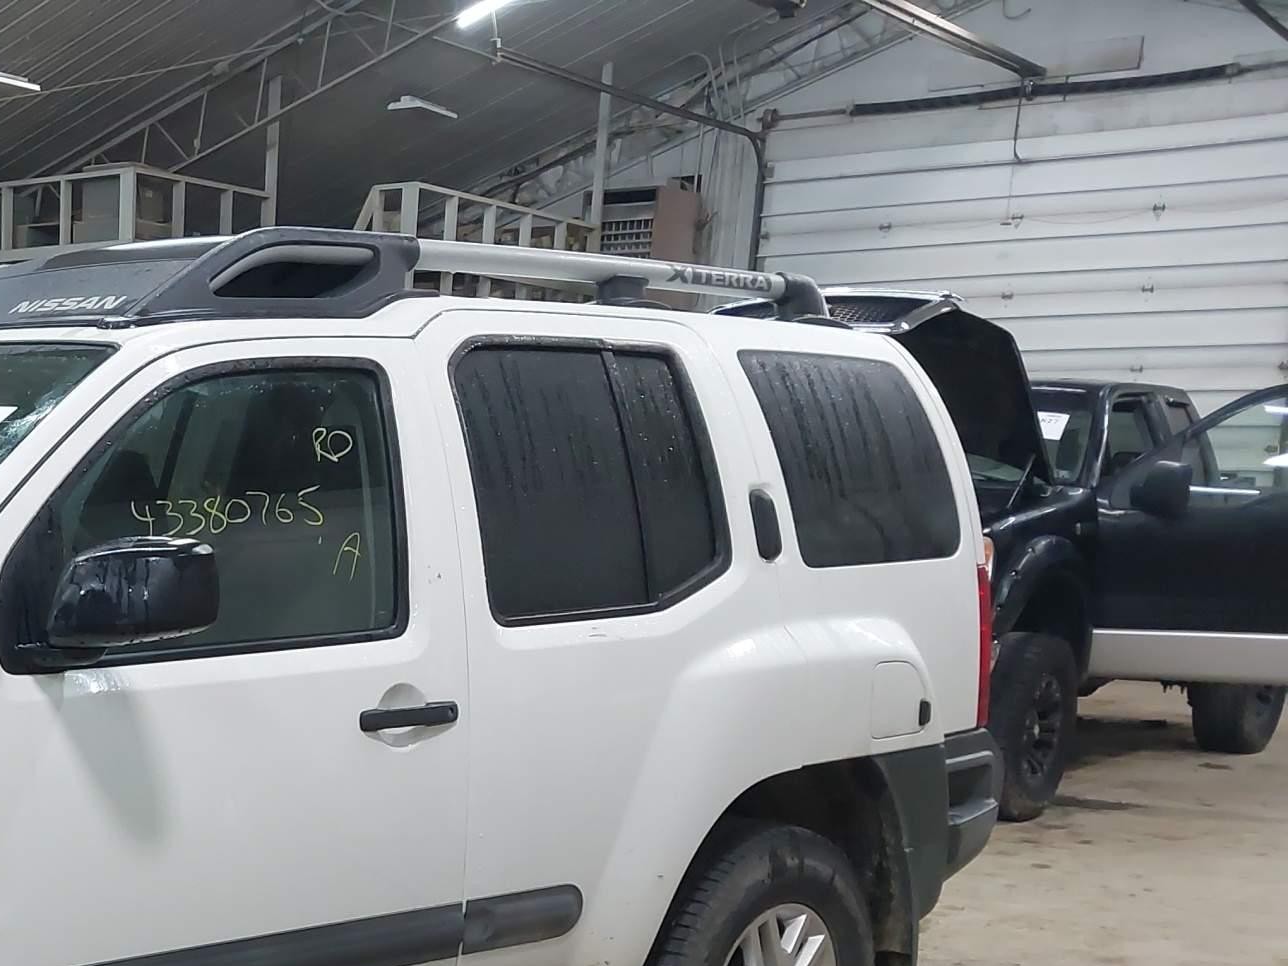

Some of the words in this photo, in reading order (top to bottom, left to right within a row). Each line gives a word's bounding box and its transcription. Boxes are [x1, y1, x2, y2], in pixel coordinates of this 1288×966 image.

[666, 267, 773, 292] XTERRA
[8, 295, 127, 314] NISSAN
[131, 485, 324, 536] 43380765
